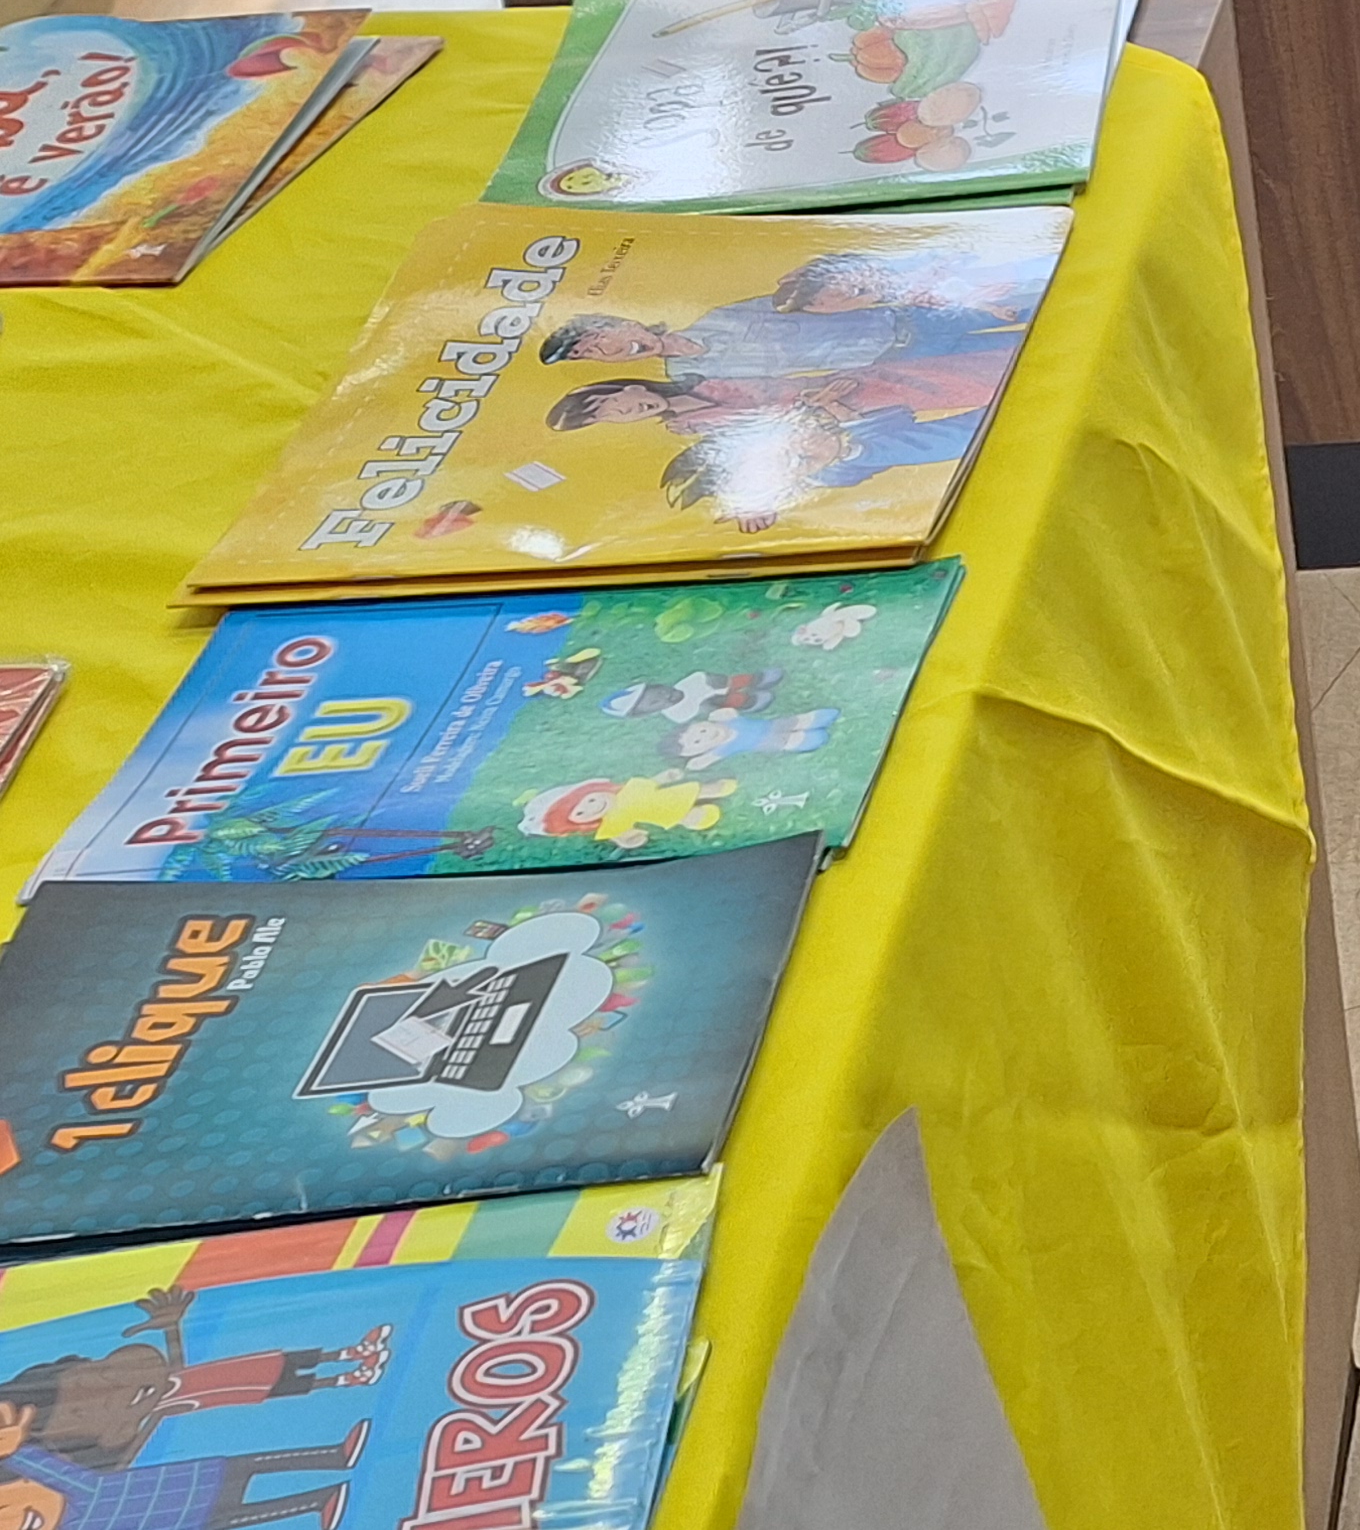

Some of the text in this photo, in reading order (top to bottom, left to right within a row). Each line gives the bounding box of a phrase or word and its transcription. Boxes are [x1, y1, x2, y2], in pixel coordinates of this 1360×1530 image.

[28, 52, 137, 164] verão!
[744, 128, 795, 152] de
[298, 235, 580, 551] Felicidade
[124, 635, 336, 847] Primeiro
[271, 696, 413, 777] EU
[48, 916, 252, 1152] 1 clique
[226, 945, 273, 990] Pablo
[398, 1278, 597, 1530] EROS
